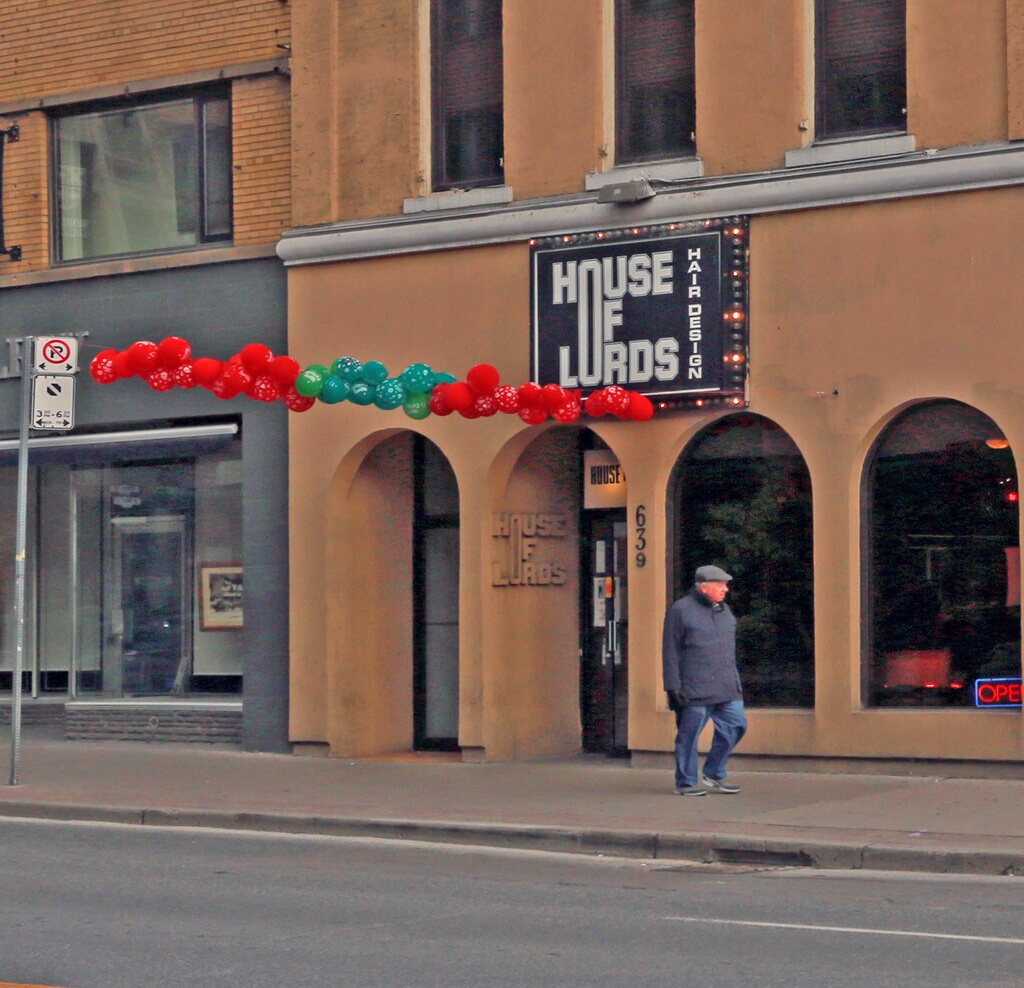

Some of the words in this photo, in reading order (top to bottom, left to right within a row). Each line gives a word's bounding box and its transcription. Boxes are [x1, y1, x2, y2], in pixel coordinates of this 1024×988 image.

[552, 250, 674, 305] HOUSE
[687, 247, 702, 299] HAIR
[559, 336, 680, 388] LORDS
[688, 303, 703, 380] DESIGN
[590, 465, 622, 485] HOUSE
[492, 512, 567, 539] HOUSE
[635, 504, 646, 568] 639
[492, 561, 568, 588] LORDS
[978, 683, 1024, 703] OPE
